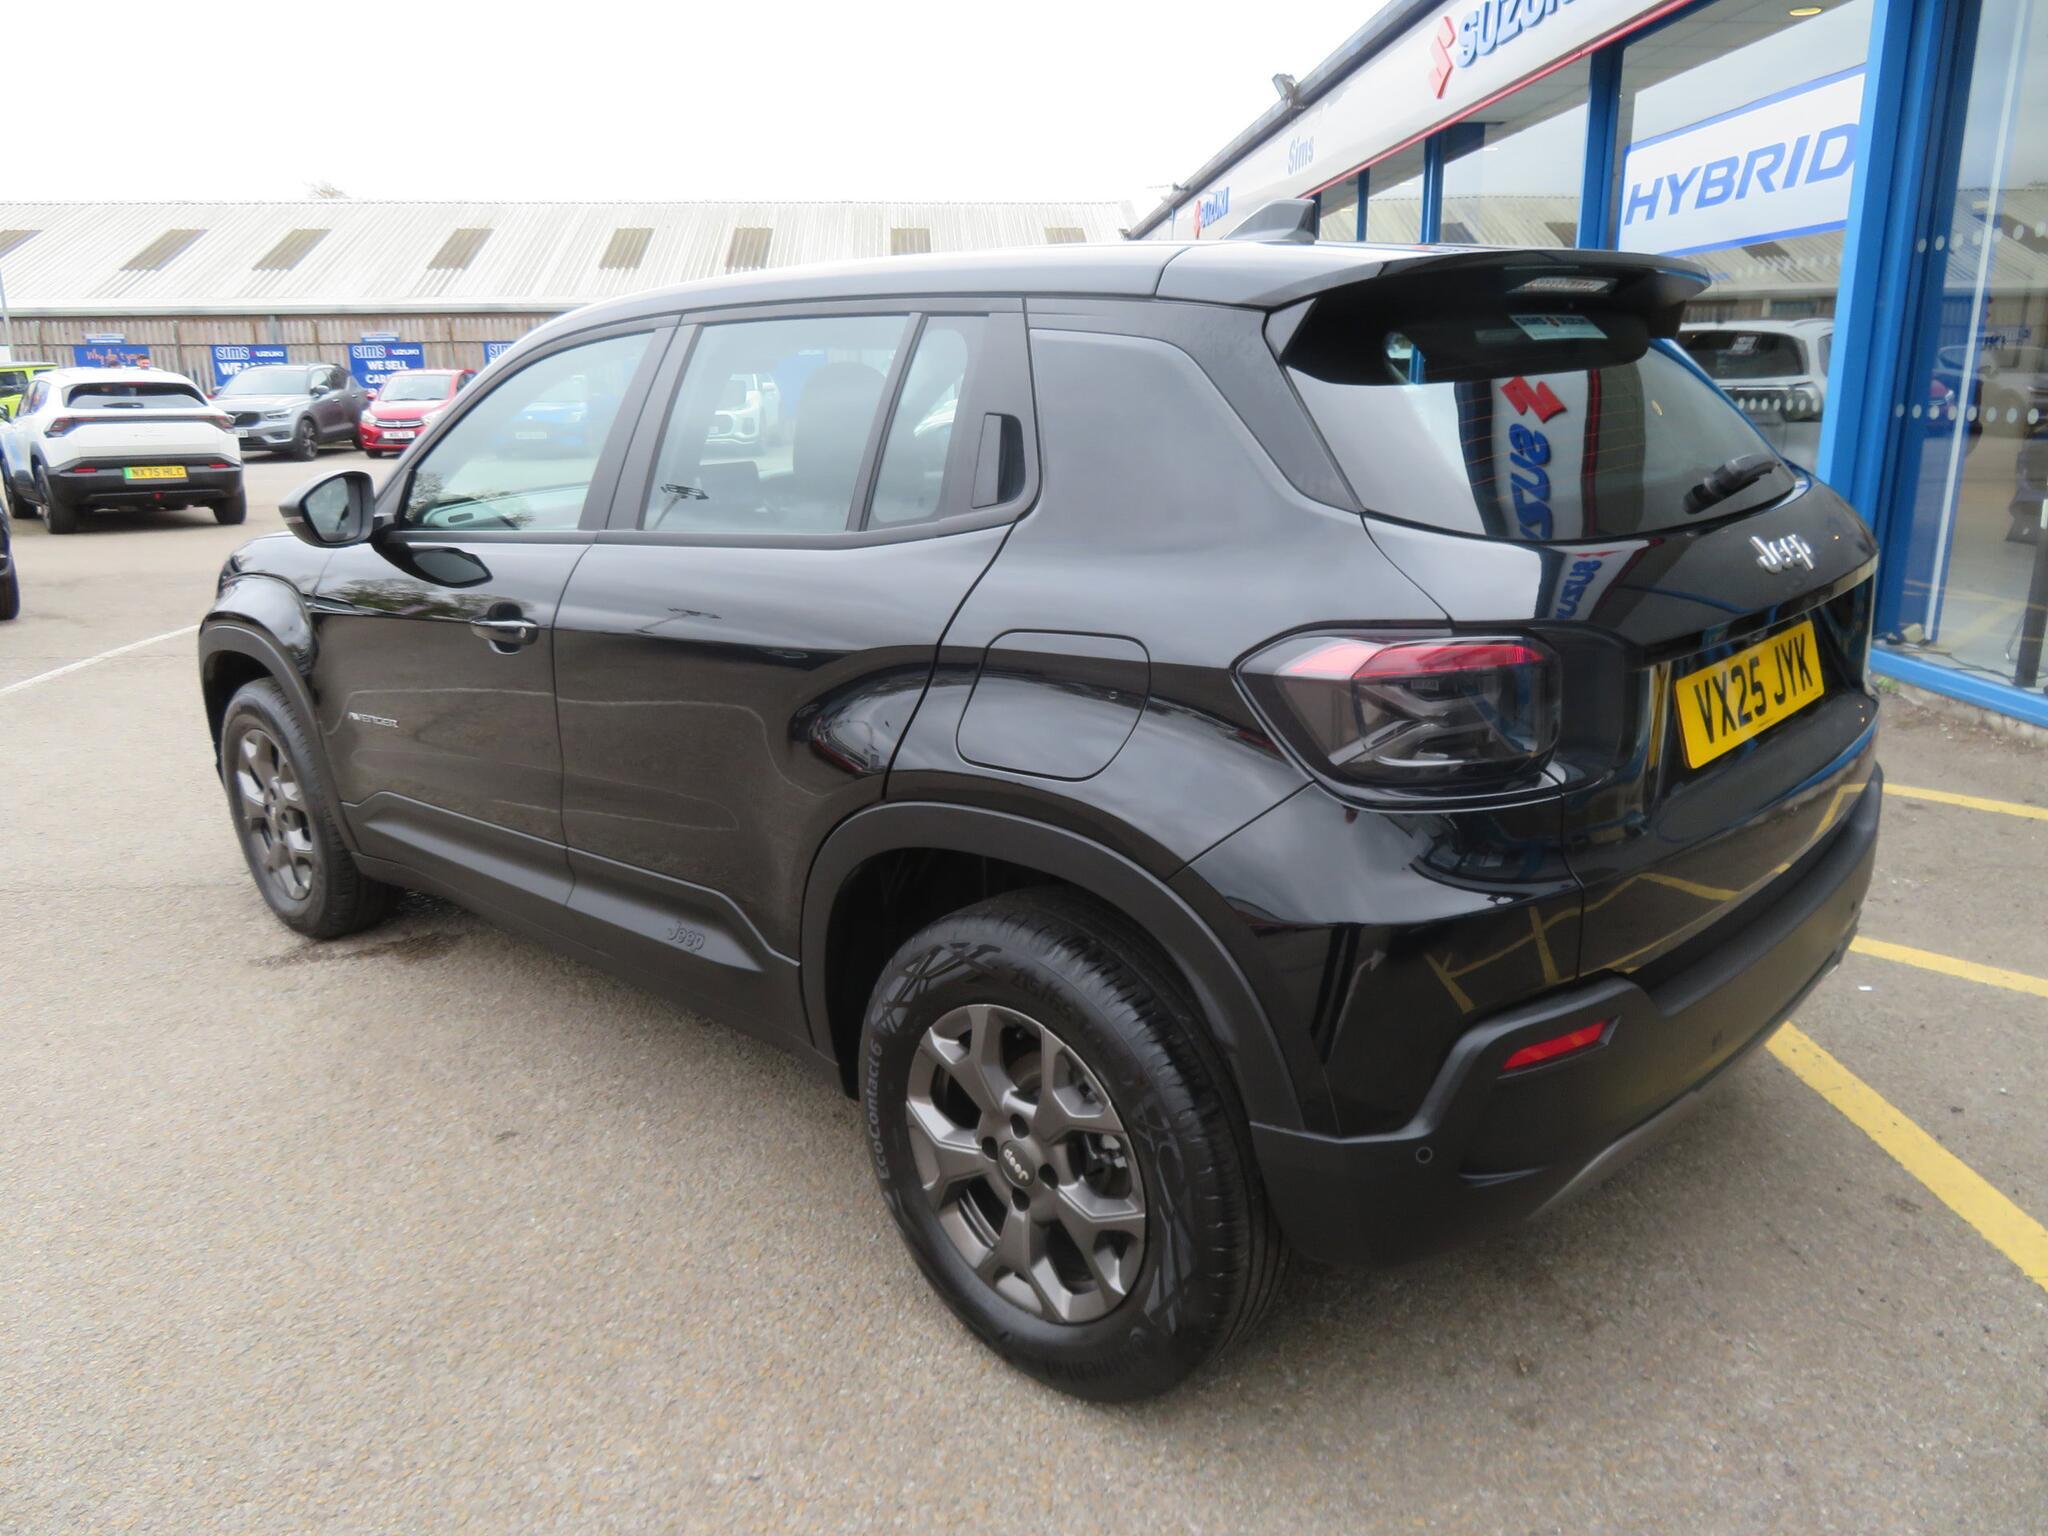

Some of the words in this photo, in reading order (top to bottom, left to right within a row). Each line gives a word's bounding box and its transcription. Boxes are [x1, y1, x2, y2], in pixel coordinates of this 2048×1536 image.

[1456, 0, 1574, 68] SUZU
[1288, 135, 1315, 175] Sims
[1624, 123, 1860, 226] HYBRID
[366, 360, 385, 371] WE
[385, 360, 409, 371] SELL
[1749, 534, 1815, 575] Jeep
[1694, 655, 1768, 745] VX25
[1774, 632, 1814, 706] JYK
[668, 920, 706, 951] Jeep
[870, 1038, 883, 1058] 6
[866, 1056, 891, 1180] EcoContact
[1003, 1148, 1029, 1180] Jeep
